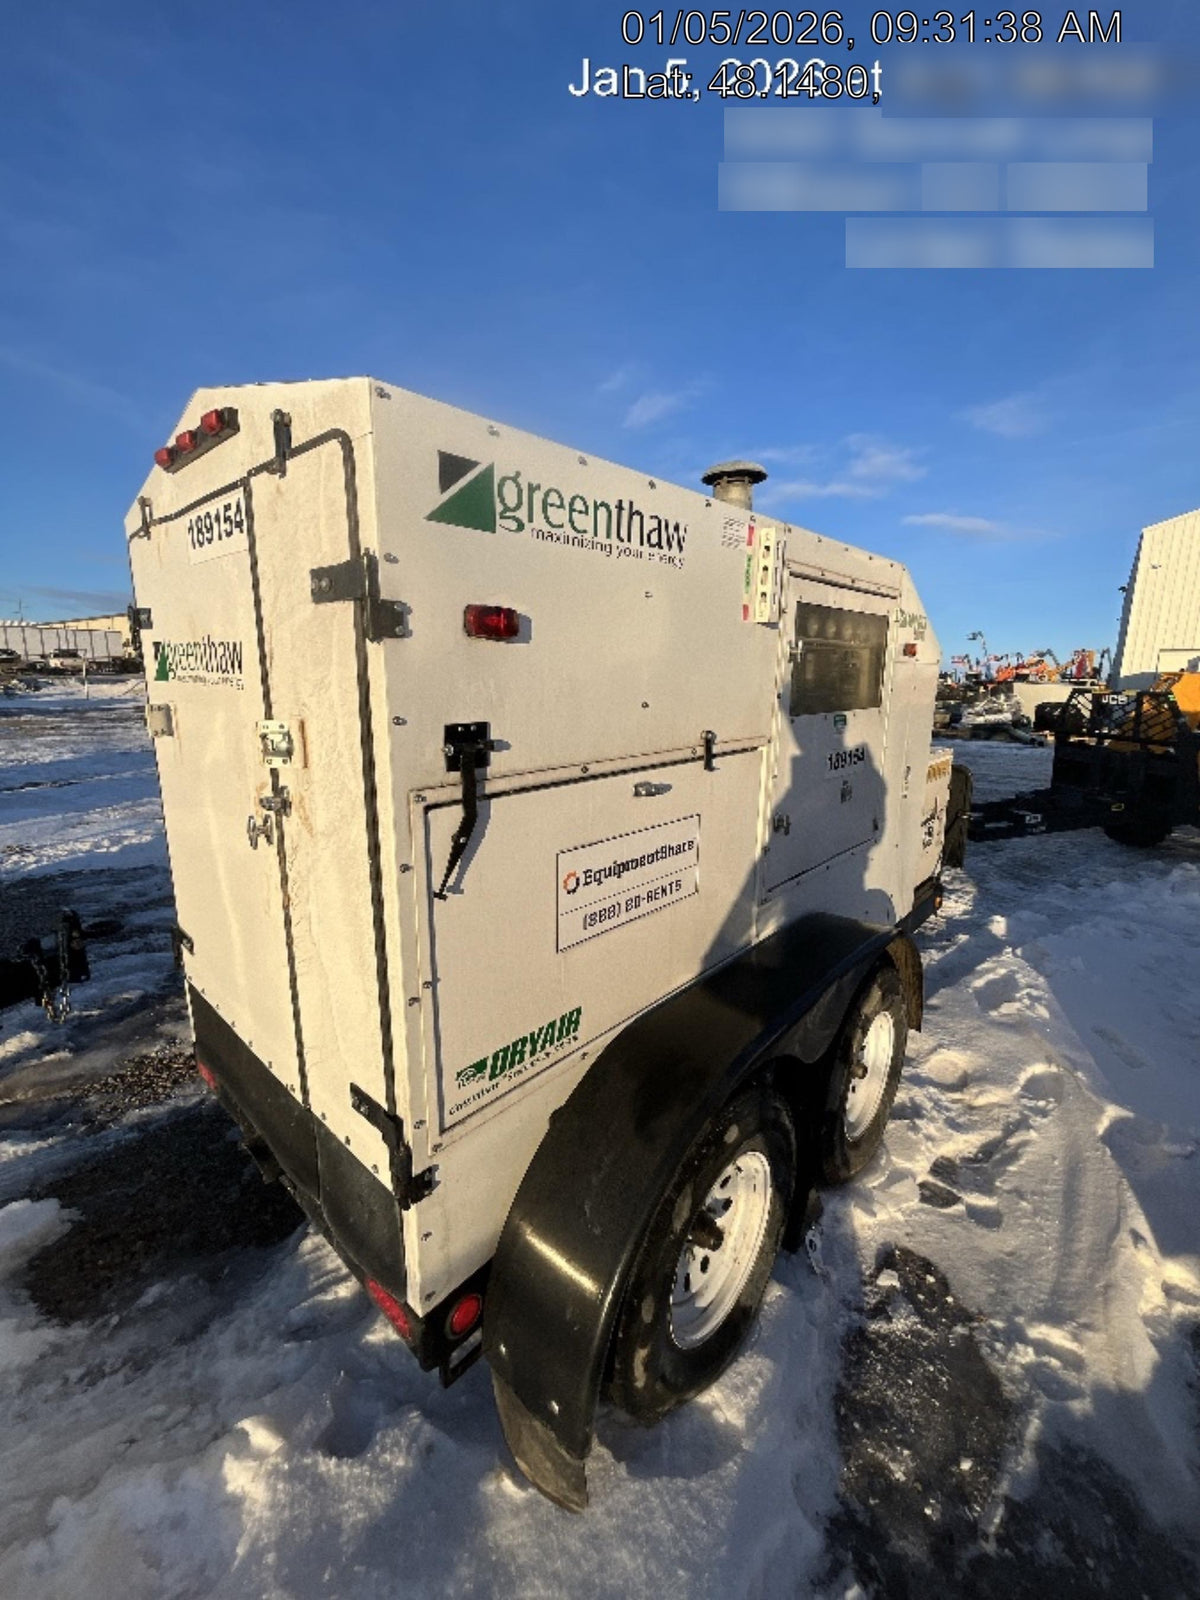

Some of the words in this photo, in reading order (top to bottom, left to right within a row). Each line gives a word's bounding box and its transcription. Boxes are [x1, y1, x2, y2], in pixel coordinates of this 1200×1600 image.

[188, 496, 244, 550] 189154
[497, 470, 688, 554] greenthaw
[167, 633, 242, 680] greenthaw
[582, 840, 694, 887] EquipmentShare
[488, 1005, 582, 1082] DRYAIR
